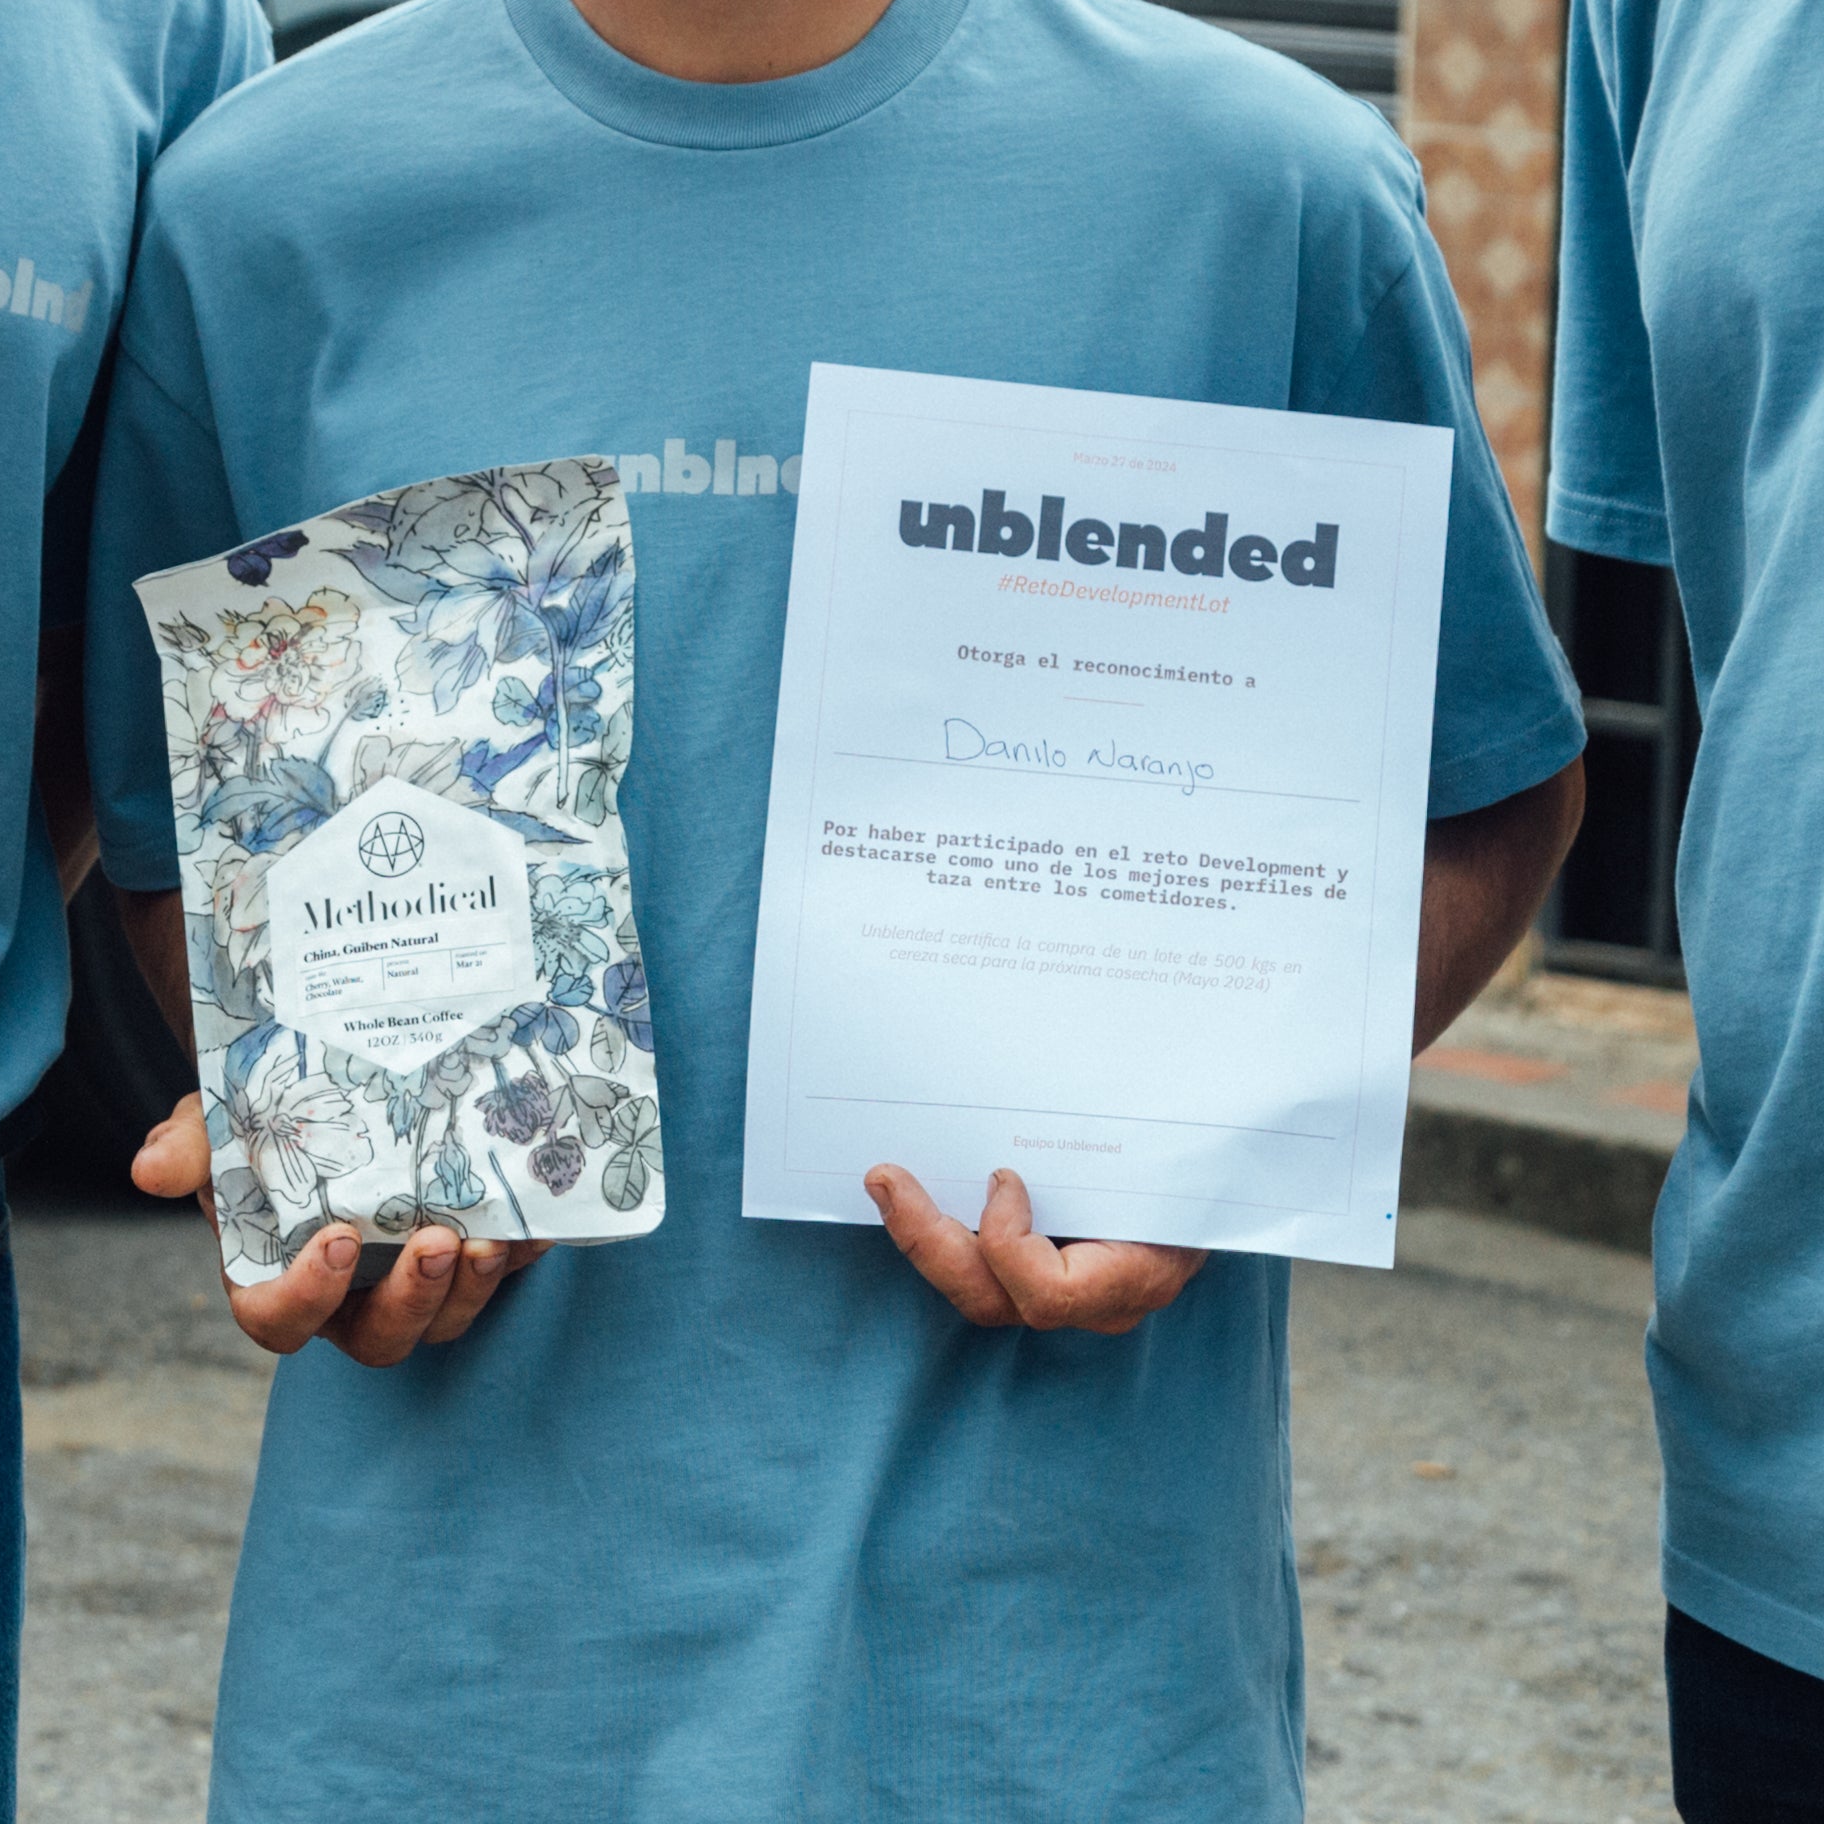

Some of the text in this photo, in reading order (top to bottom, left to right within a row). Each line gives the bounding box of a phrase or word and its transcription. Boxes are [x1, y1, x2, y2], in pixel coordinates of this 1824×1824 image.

[604, 438, 804, 495] nbln
[1073, 452, 1109, 466] Marzo
[1129, 458, 1144, 470] de
[1146, 459, 1177, 473] 2024
[898, 488, 1340, 588] unblended
[996, 573, 1231, 615] #RetoDevelopmentLot
[957, 645, 1256, 688] Otorga el reconocimiento a
[944, 718, 1214, 796] Danilo Naranjo
[821, 840, 1347, 900] destacarse como uno de los mejores perfiles de
[823, 820, 1349, 883] Por haber participado en el reto Development y
[303, 876, 497, 934] Methodical
[926, 870, 1236, 911] taza entre los cometidores.
[303, 933, 439, 963] China, Guiben Natural
[456, 960, 472, 969] Mar
[860, 923, 1302, 975] Unblended certifica la compra de un lote de 500 kgs en
[387, 967, 419, 978] Natural
[889, 947, 1271, 993] cereza seca para la próxima cosecha (Mayo 2024)
[344, 1010, 463, 1033] Whole Bean Coffee
[1013, 1135, 1122, 1154] Equipo Unblended
